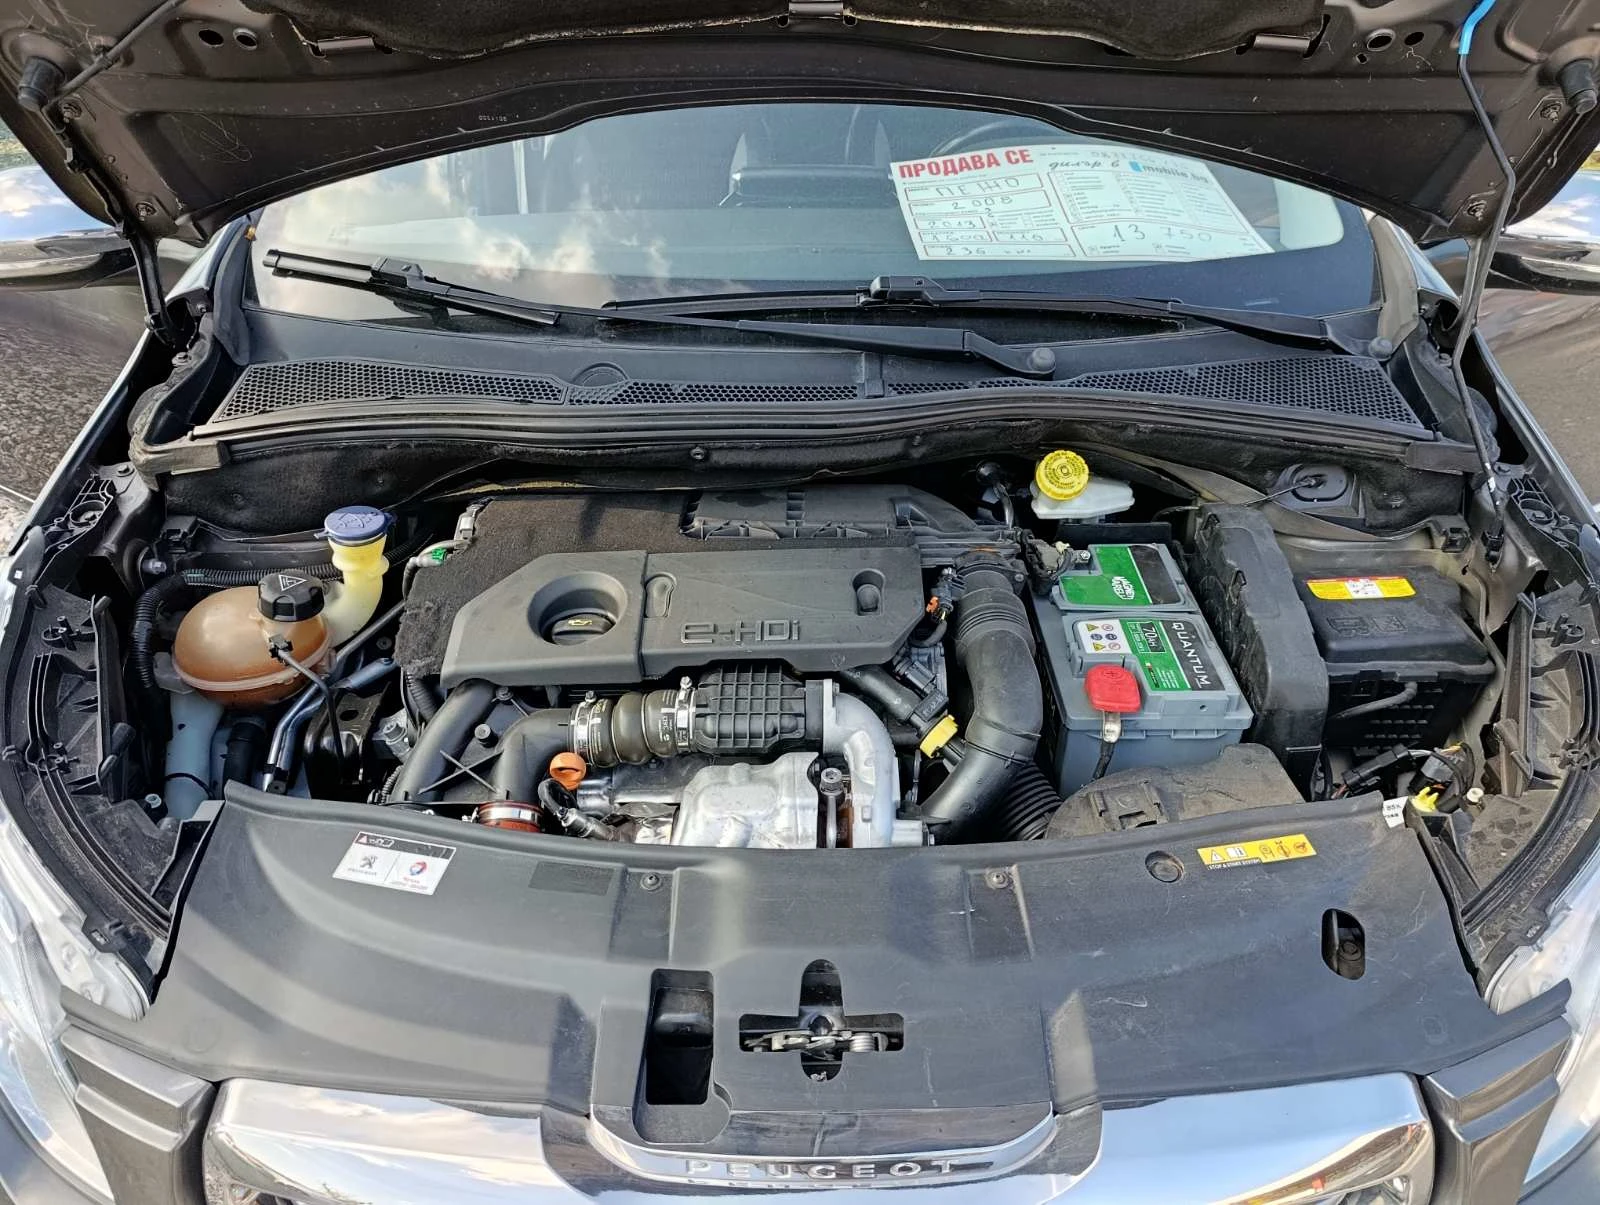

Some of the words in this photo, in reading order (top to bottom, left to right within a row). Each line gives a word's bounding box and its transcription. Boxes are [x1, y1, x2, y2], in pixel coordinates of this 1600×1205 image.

[899, 152, 1001, 178] ПРОДАВА
[1004, 149, 1034, 164] СЕ
[936, 177, 1020, 197] ПЕЖО
[952, 195, 1013, 210] 2008
[1114, 223, 1146, 242] 13
[1172, 622, 1212, 688] QUANTUM
[686, 1158, 960, 1180] PEUGEOT
